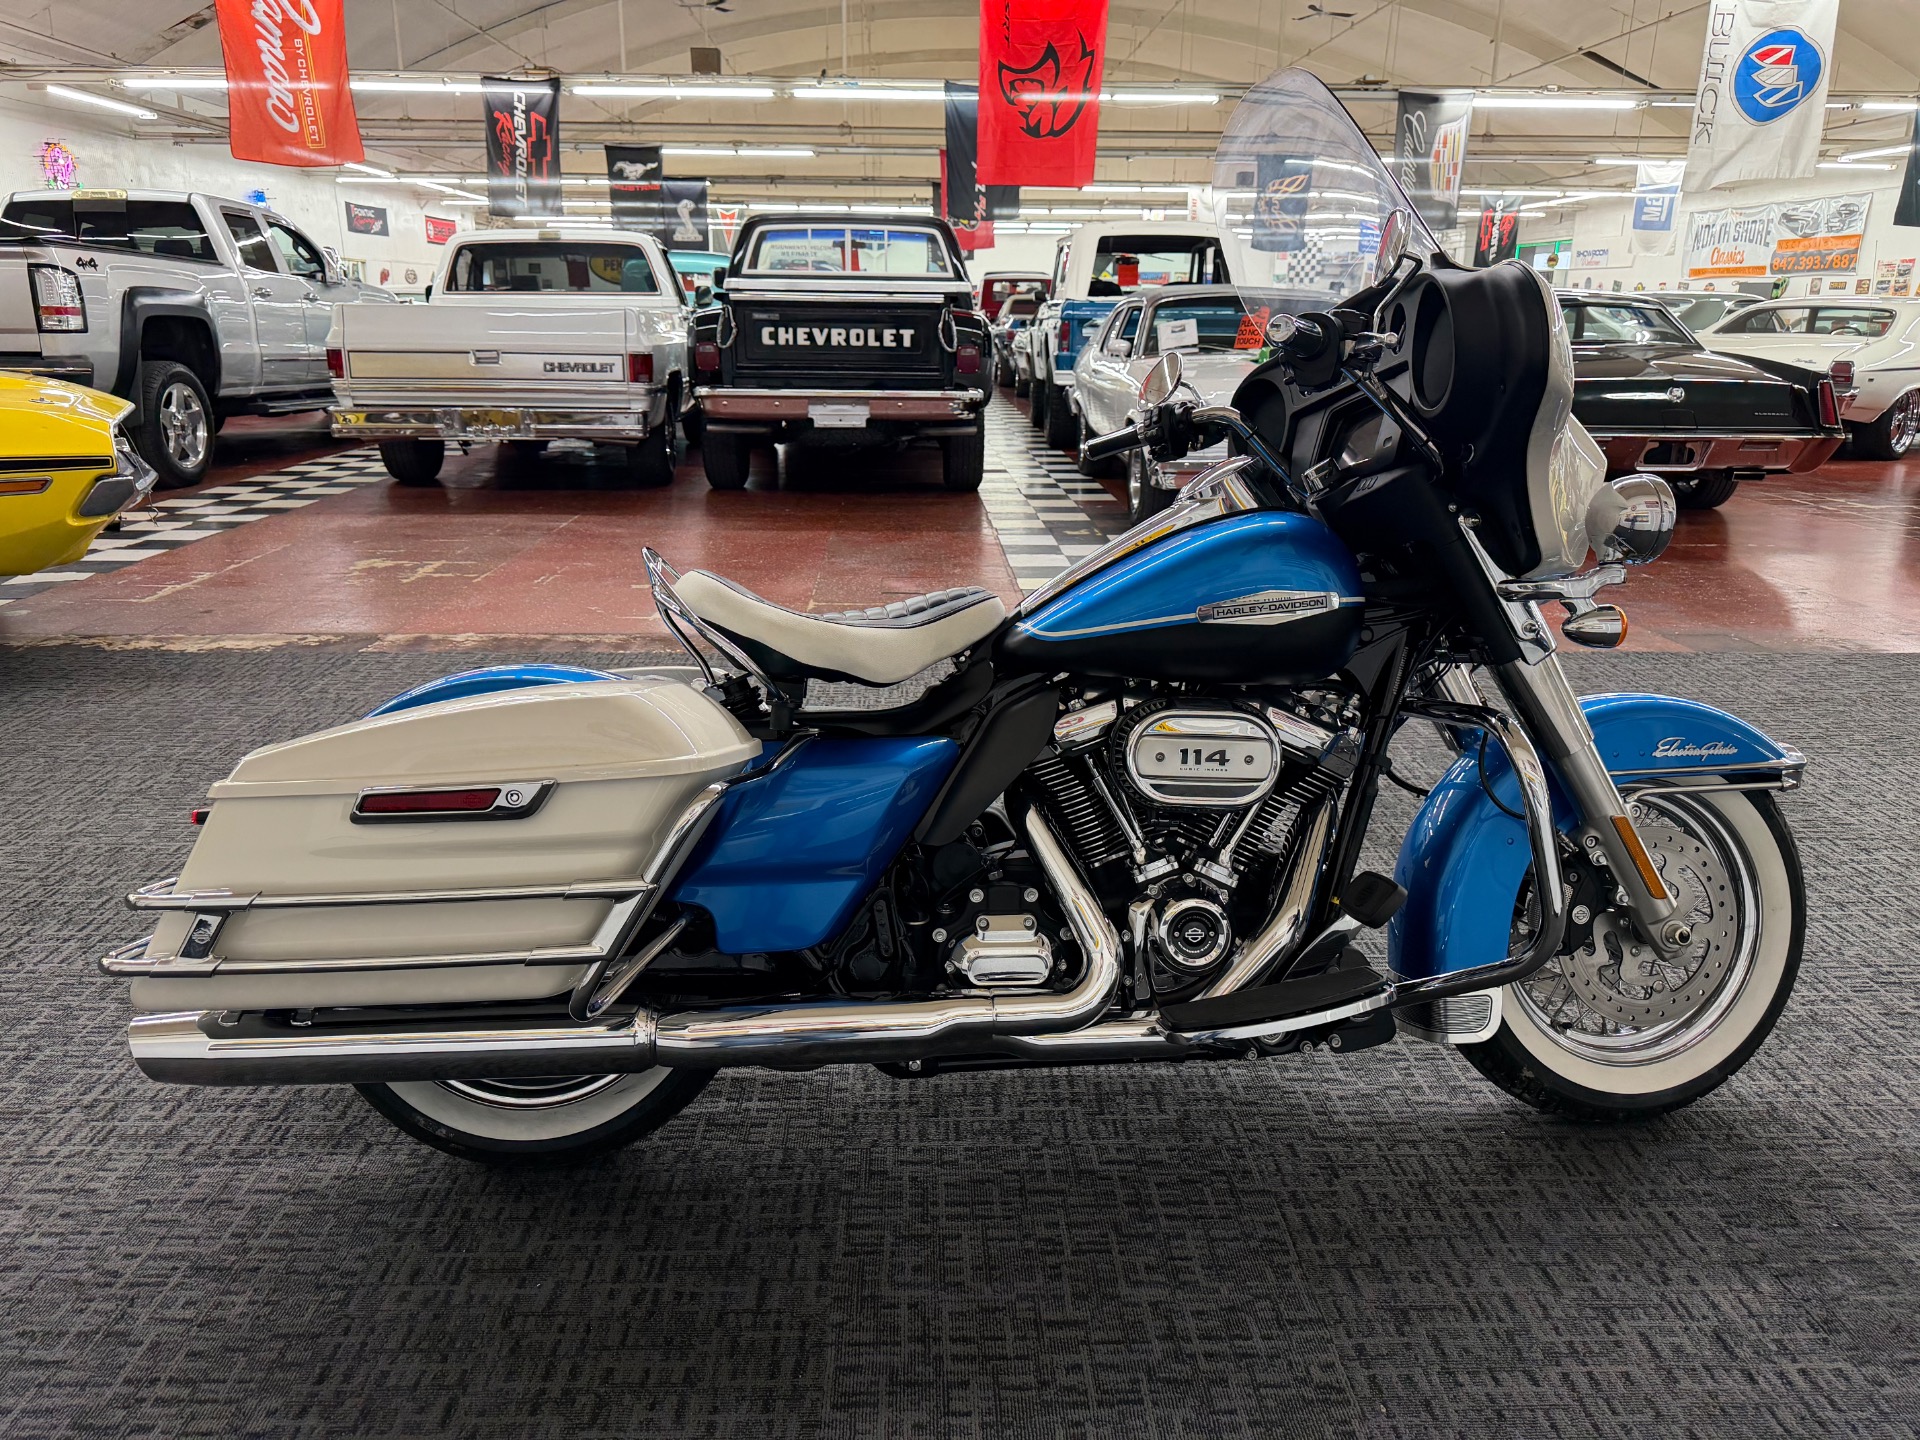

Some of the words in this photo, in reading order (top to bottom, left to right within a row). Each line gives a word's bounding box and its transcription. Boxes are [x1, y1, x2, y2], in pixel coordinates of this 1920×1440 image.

[294, 38, 305, 57] BY
[1695, 4, 1737, 145] BUICK
[297, 58, 320, 142] CHEVROLET
[493, 110, 516, 177] Racing
[513, 91, 528, 209] CHEVROLET
[1692, 221, 1730, 252] NORTH
[1732, 218, 1775, 248] SHORE
[1710, 245, 1745, 267] Classics
[1772, 253, 1858, 271] 847.393.7887
[761, 326, 915, 348] CHEVROLET
[1236, 337, 1261, 346] TOUCH
[543, 362, 615, 373] CHEVROLET
[1216, 598, 1325, 617] HARLEY-DAVIDSON
[1179, 748, 1231, 766] 114
